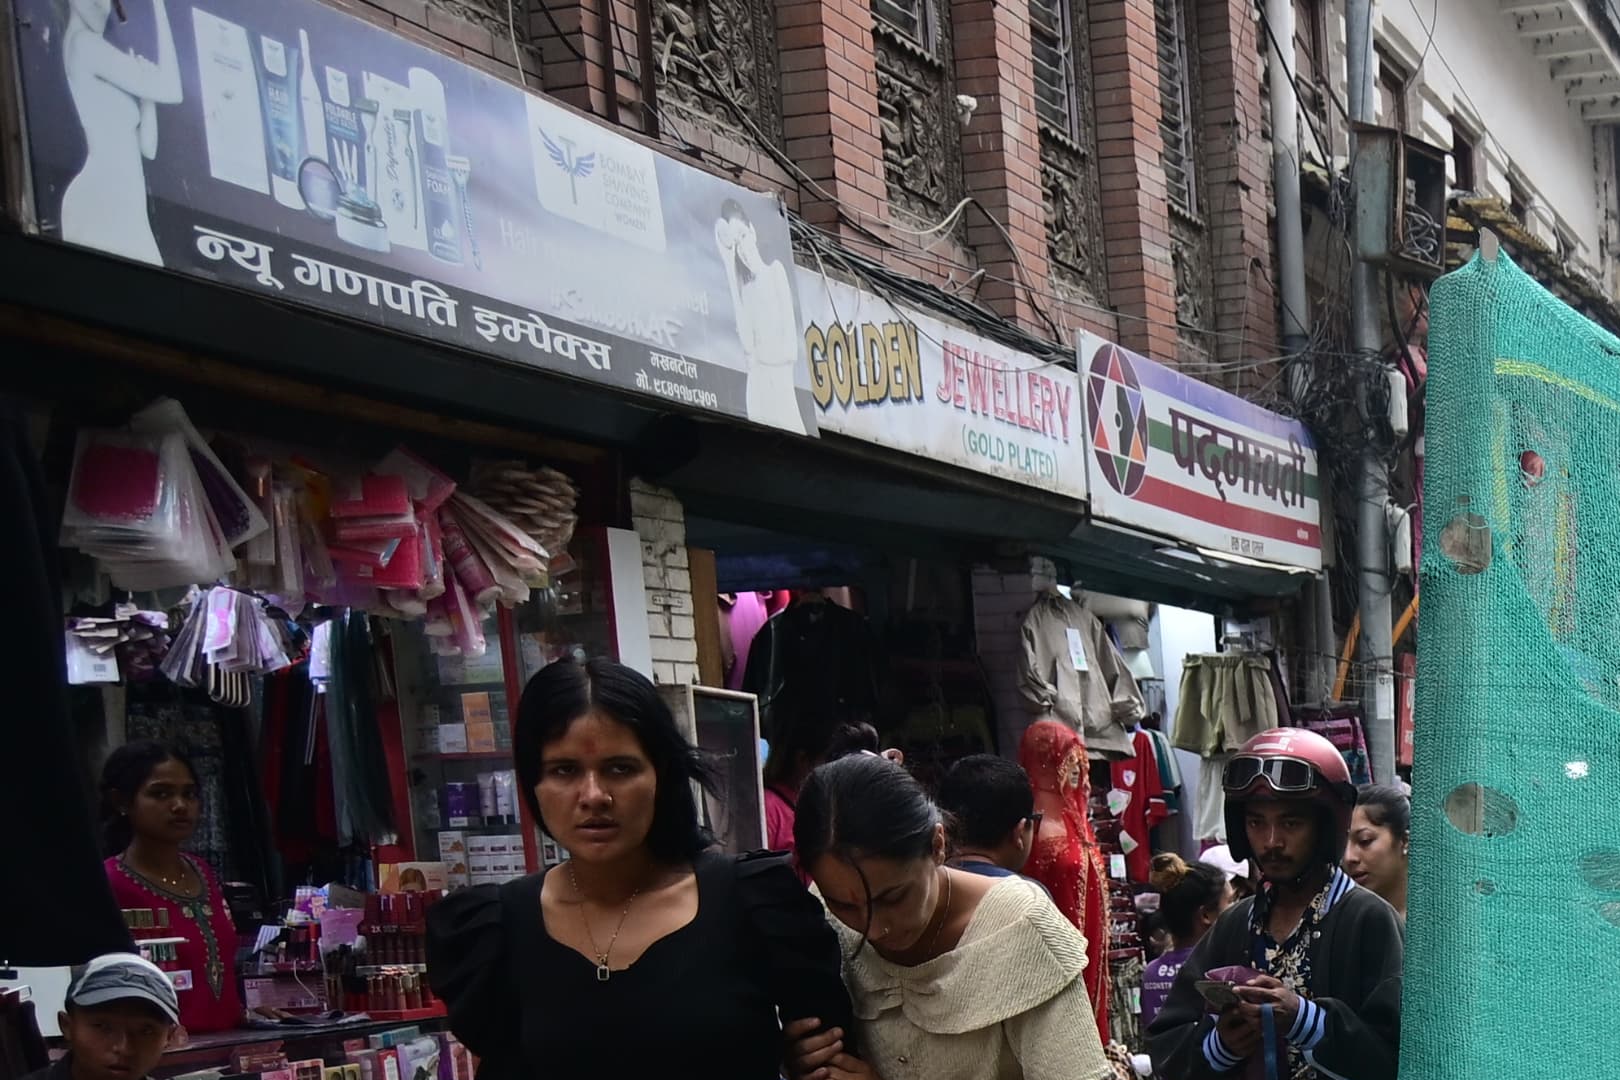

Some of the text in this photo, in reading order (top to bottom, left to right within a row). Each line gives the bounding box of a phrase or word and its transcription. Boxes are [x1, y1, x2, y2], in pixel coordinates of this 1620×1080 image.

[599, 152, 647, 185] BOMBAY
[602, 173, 649, 203] SHAVING
[605, 191, 650, 220] COMPANY
[615, 212, 647, 232] WOMEN
[193, 225, 285, 290] न्यू
[290, 252, 459, 328] गणपति
[472, 306, 611, 371] इम्पेक्स
[804, 320, 1072, 444] GOLDEN JEWELLERY
[961, 424, 1058, 481] (GOLD PLATED)
